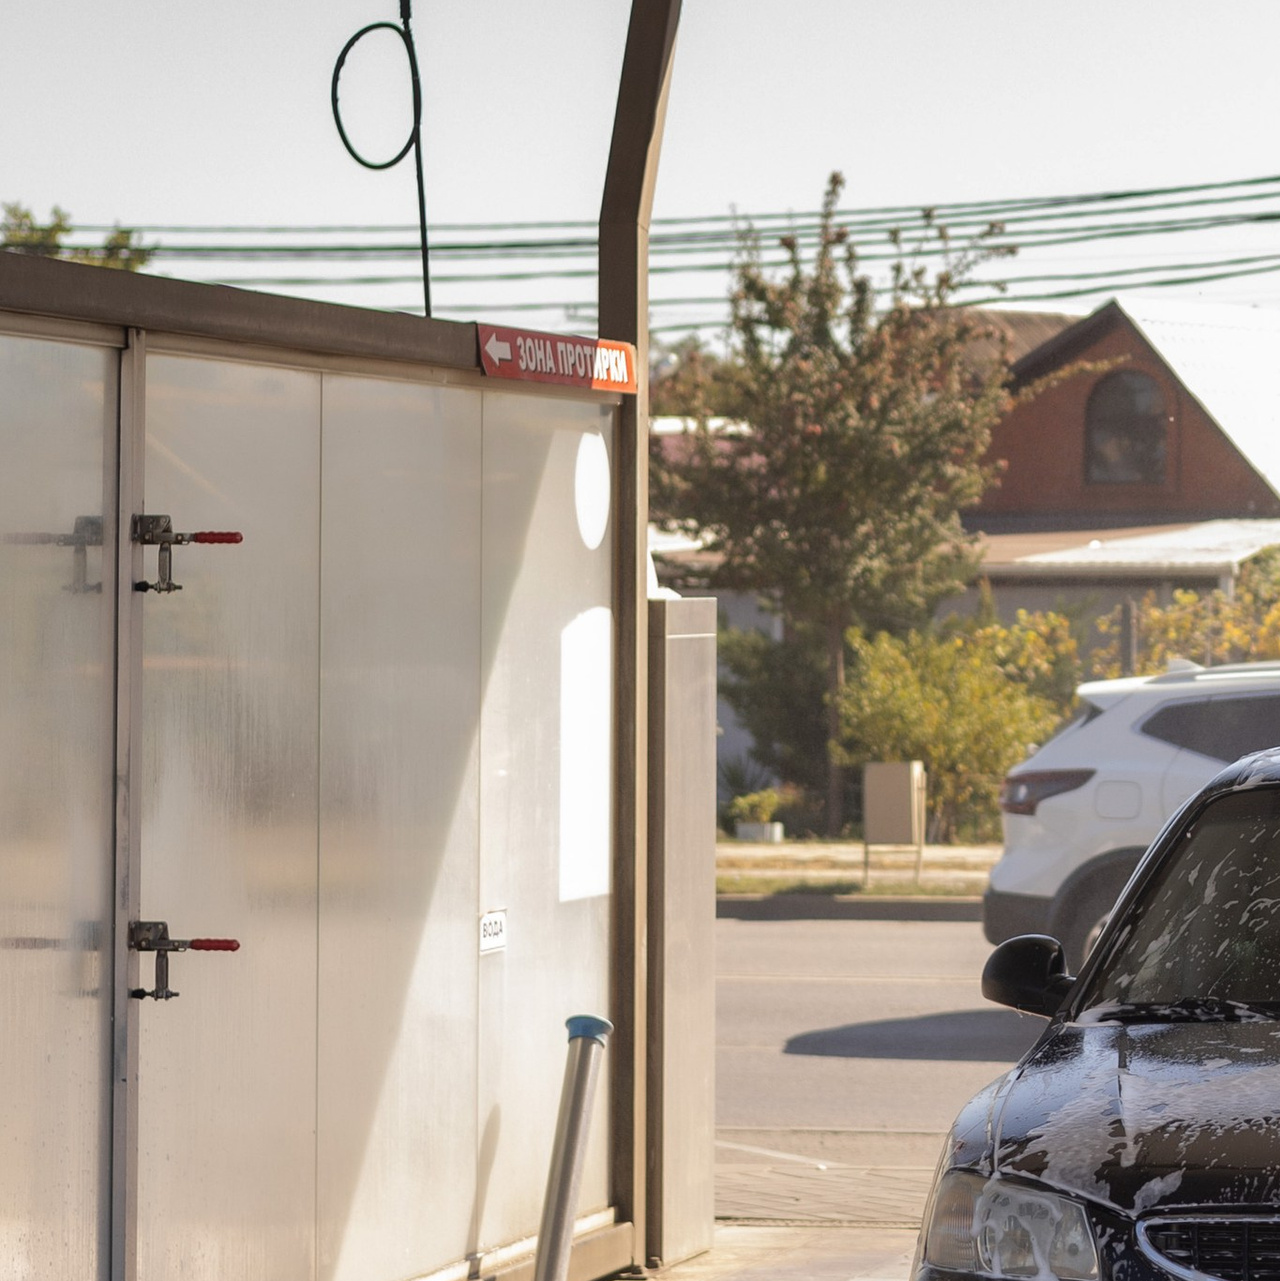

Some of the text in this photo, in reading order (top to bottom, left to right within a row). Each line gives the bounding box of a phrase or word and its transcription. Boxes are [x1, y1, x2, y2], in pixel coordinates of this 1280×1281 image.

[516, 335, 629, 384] ЗОНА ПРОТИРКИ
[482, 920, 503, 938] ВОДА
